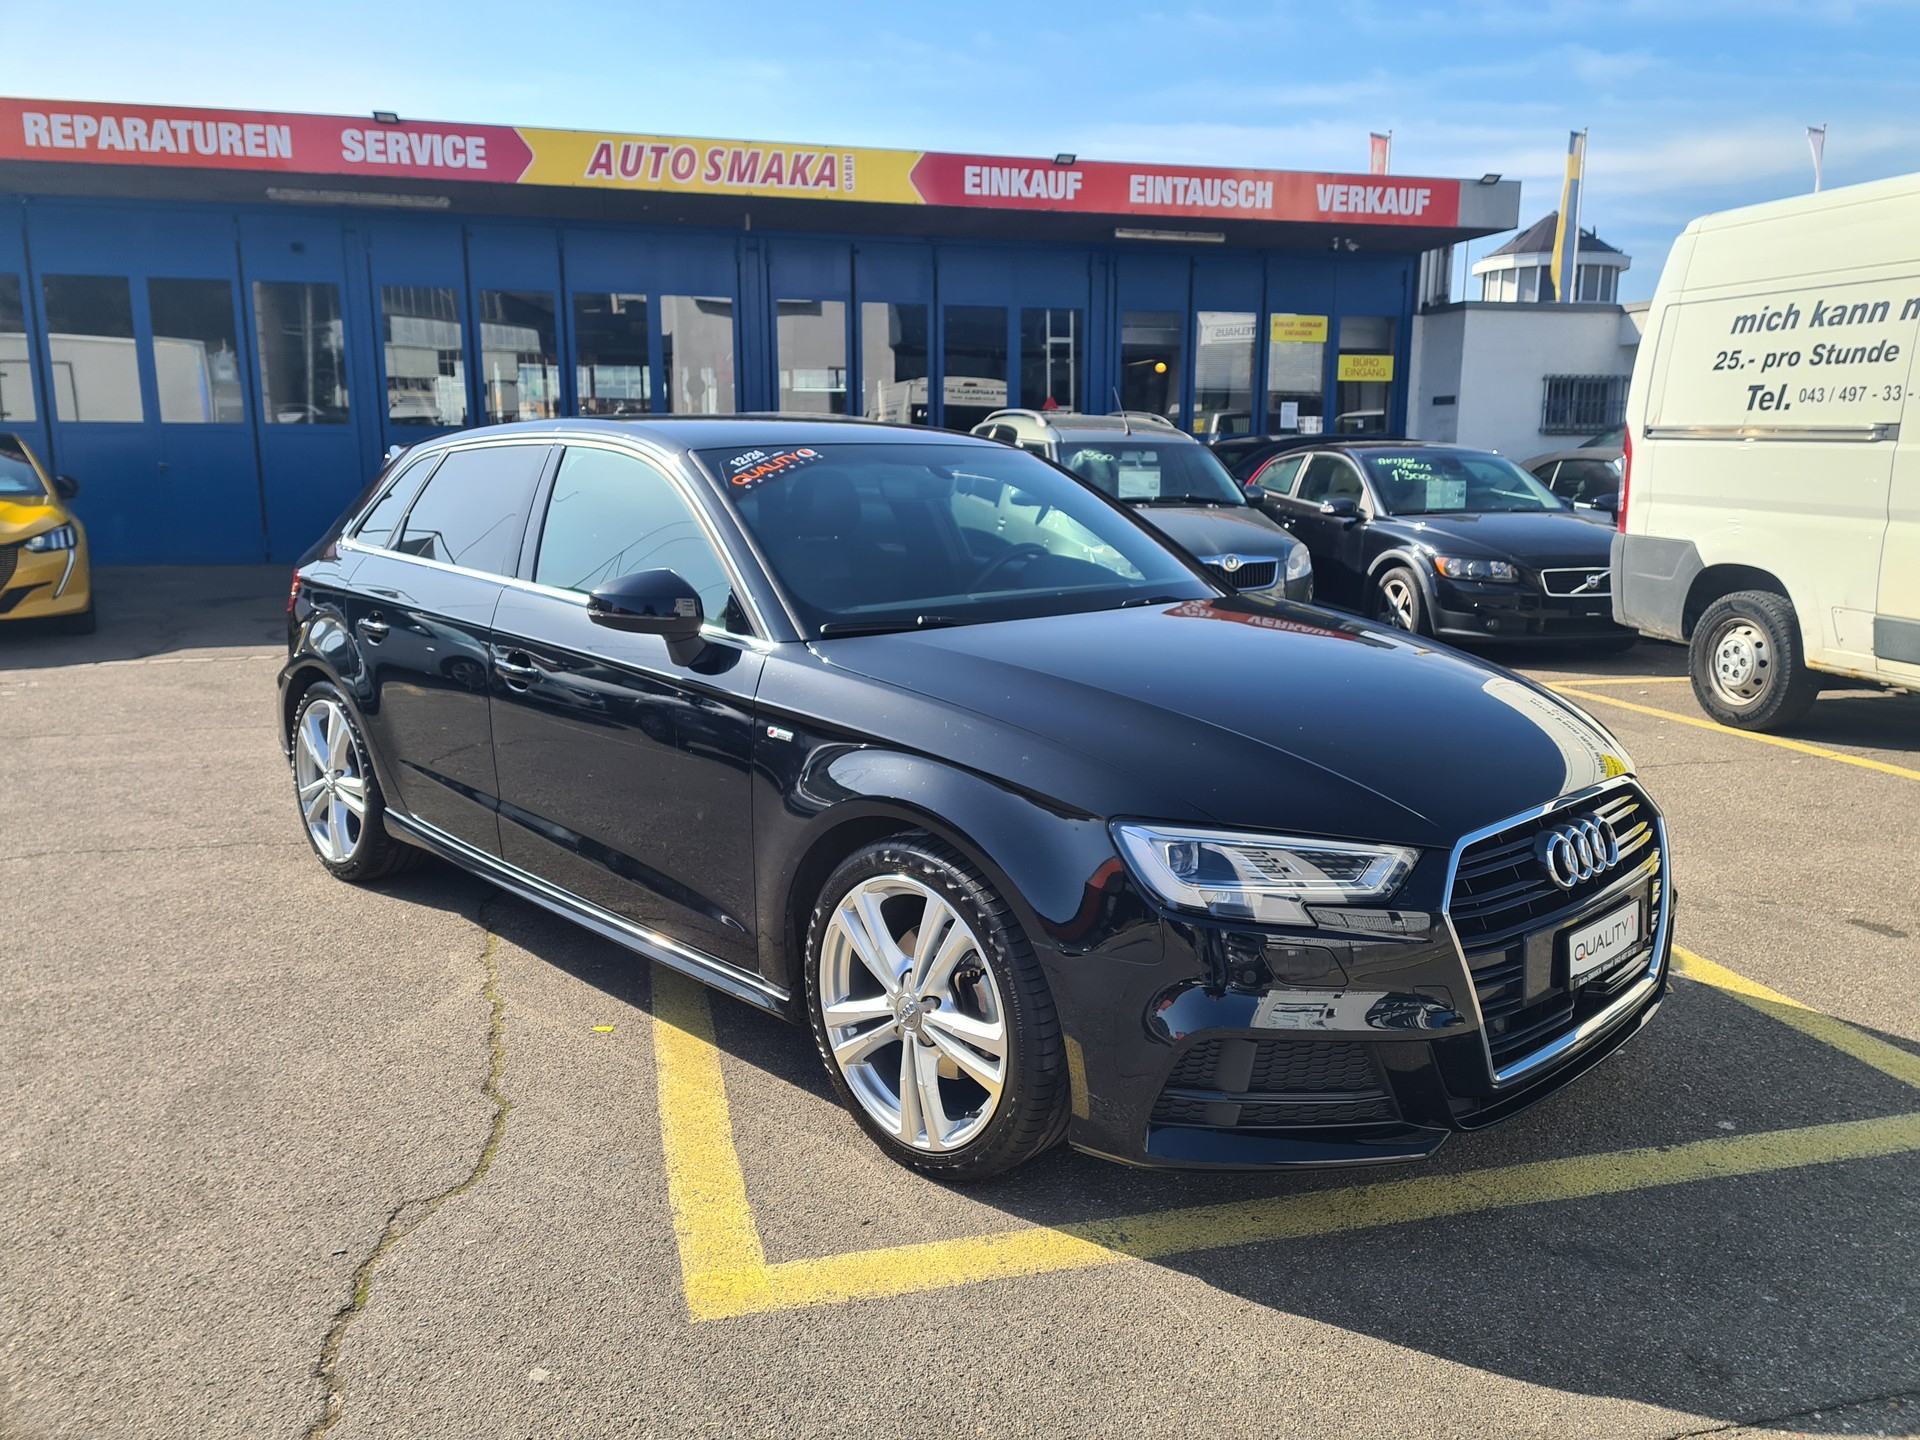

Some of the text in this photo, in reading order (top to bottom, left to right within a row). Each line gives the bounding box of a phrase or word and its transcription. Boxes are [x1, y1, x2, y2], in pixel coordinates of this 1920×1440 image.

[22, 112, 292, 159] REPARATUREN
[341, 129, 488, 169] SERVICE
[586, 141, 839, 189] AUTO SMAKA
[964, 166, 1083, 200] EINKAUF
[1129, 174, 1273, 209] EINTAUSCH
[1316, 184, 1431, 216] VERKAUF
[1730, 303, 1801, 335] mich
[1809, 300, 1890, 328] kann
[1344, 367, 1386, 378] EINGANG
[1352, 357, 1379, 367] BÜRO
[1760, 349, 1801, 373] pro
[1809, 340, 1900, 365] Stunde
[1747, 384, 1791, 411] Tel.
[730, 449, 765, 467] 12/24
